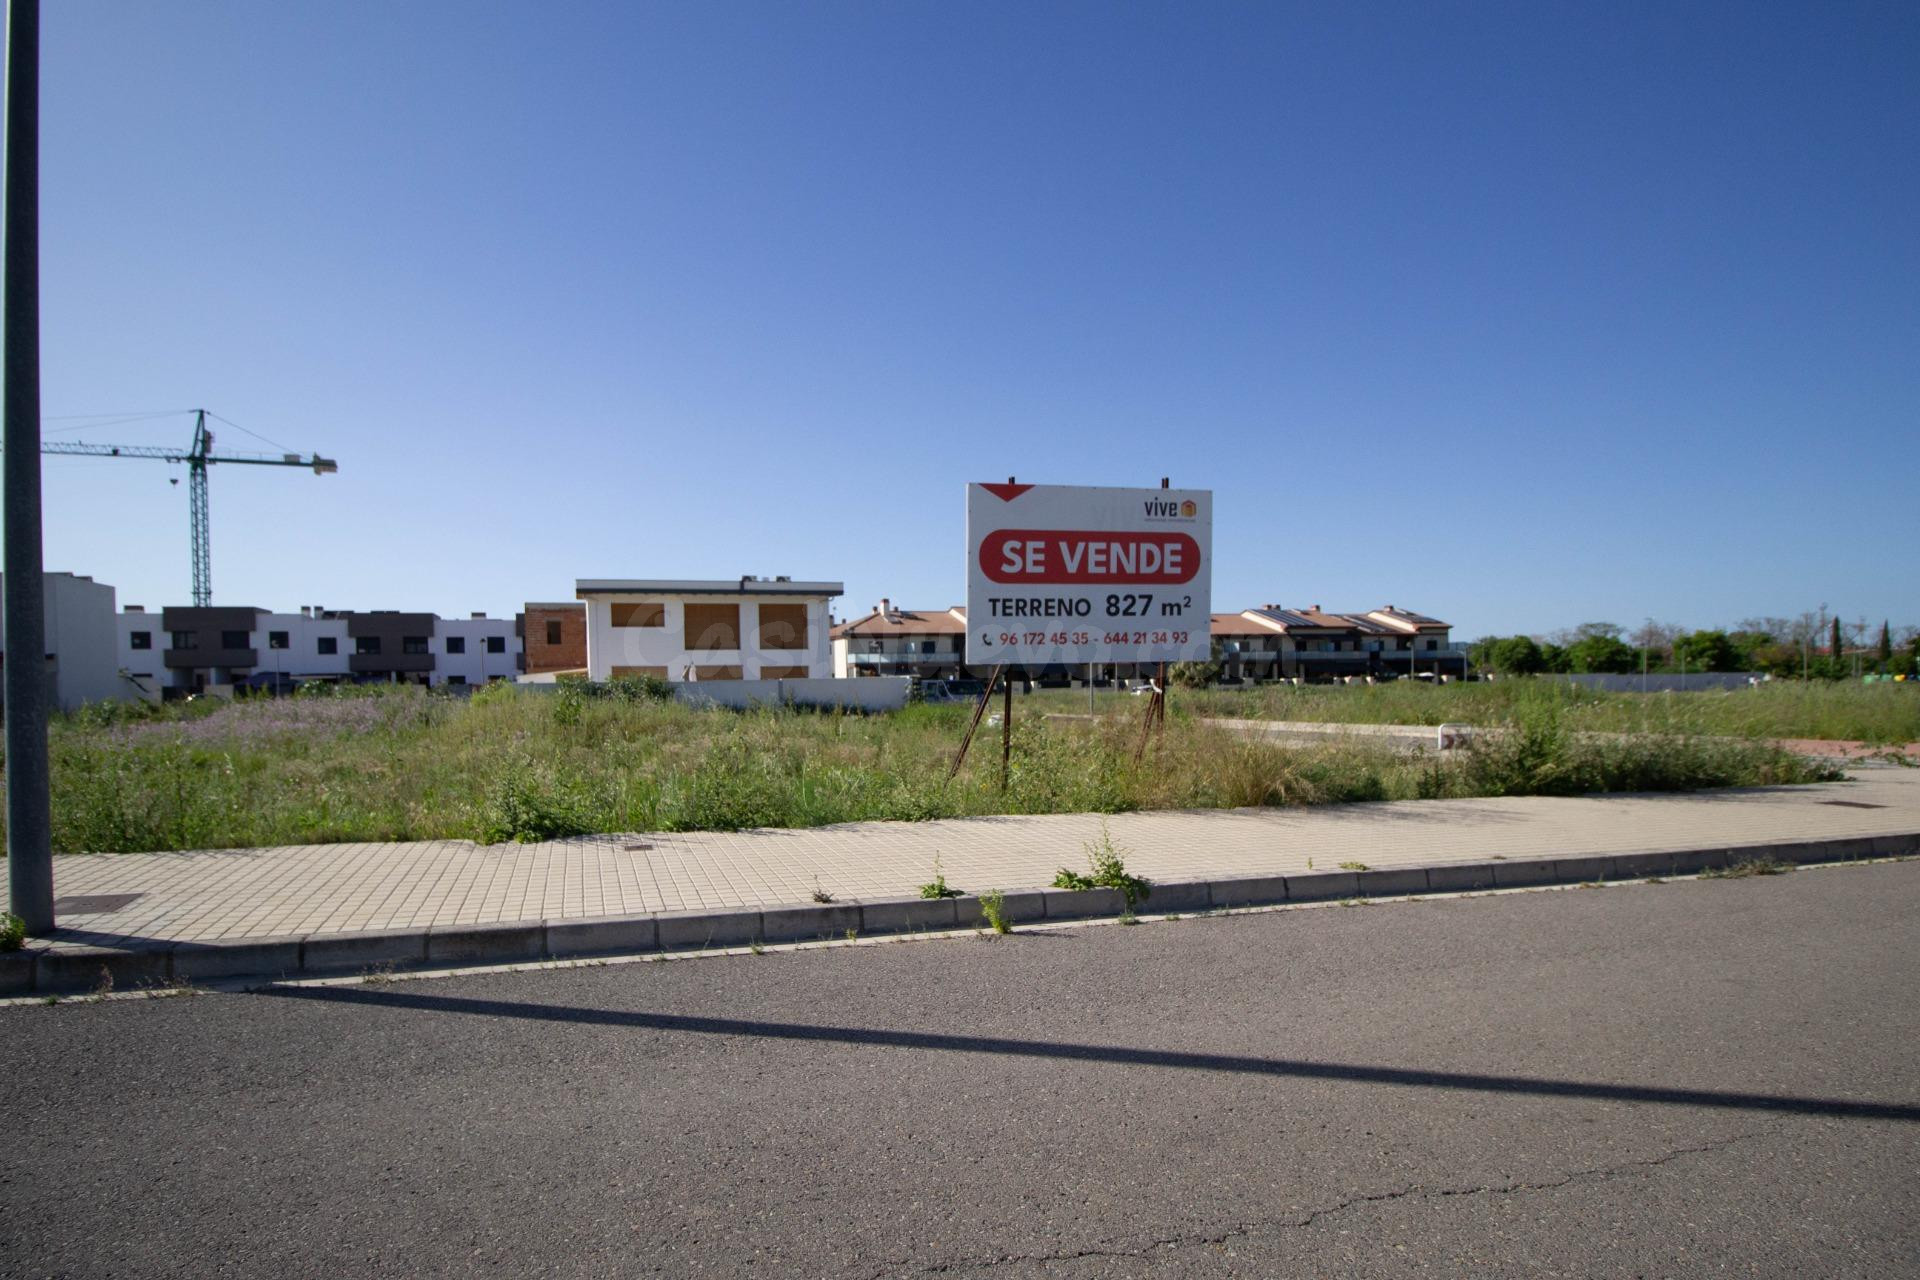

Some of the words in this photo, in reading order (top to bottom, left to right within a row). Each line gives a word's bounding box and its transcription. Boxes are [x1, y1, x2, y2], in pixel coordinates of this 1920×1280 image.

[1000, 540, 1046, 574] SE
[1059, 541, 1182, 574] VENDE
[989, 598, 1091, 617] TERRENO
[1105, 594, 1153, 617] 827
[999, 633, 1018, 645] 96
[1024, 633, 1045, 645] 172
[1050, 633, 1068, 645] 45
[1072, 633, 1089, 645] 35
[1103, 632, 1129, 645] 644
[1133, 632, 1147, 645] 21
[1151, 632, 1168, 644] 34
[1172, 632, 1188, 644] 93
